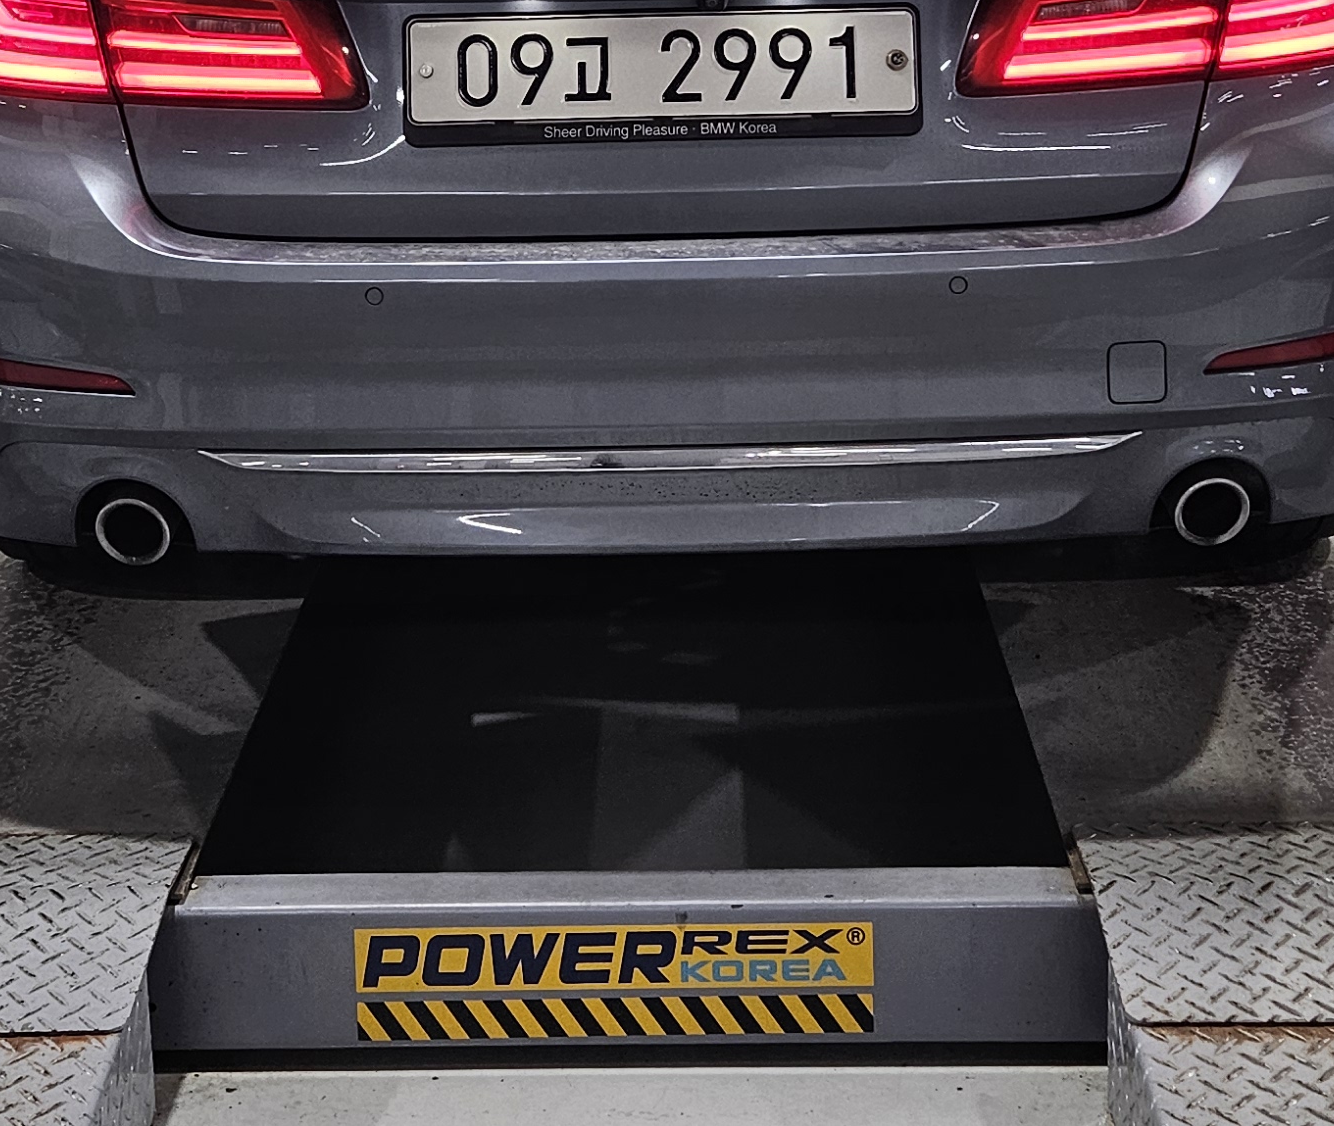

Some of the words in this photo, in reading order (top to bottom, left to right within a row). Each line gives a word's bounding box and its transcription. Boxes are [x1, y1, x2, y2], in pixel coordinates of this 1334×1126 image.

[457, 33, 612, 108] 09고
[660, 26, 856, 102] 2991
[544, 126, 582, 138] Sheer
[585, 125, 629, 140] Driving
[633, 124, 688, 137] Pleasure
[700, 122, 736, 135] BMW
[739, 121, 777, 134] Korea
[680, 958, 847, 984] KOREA
